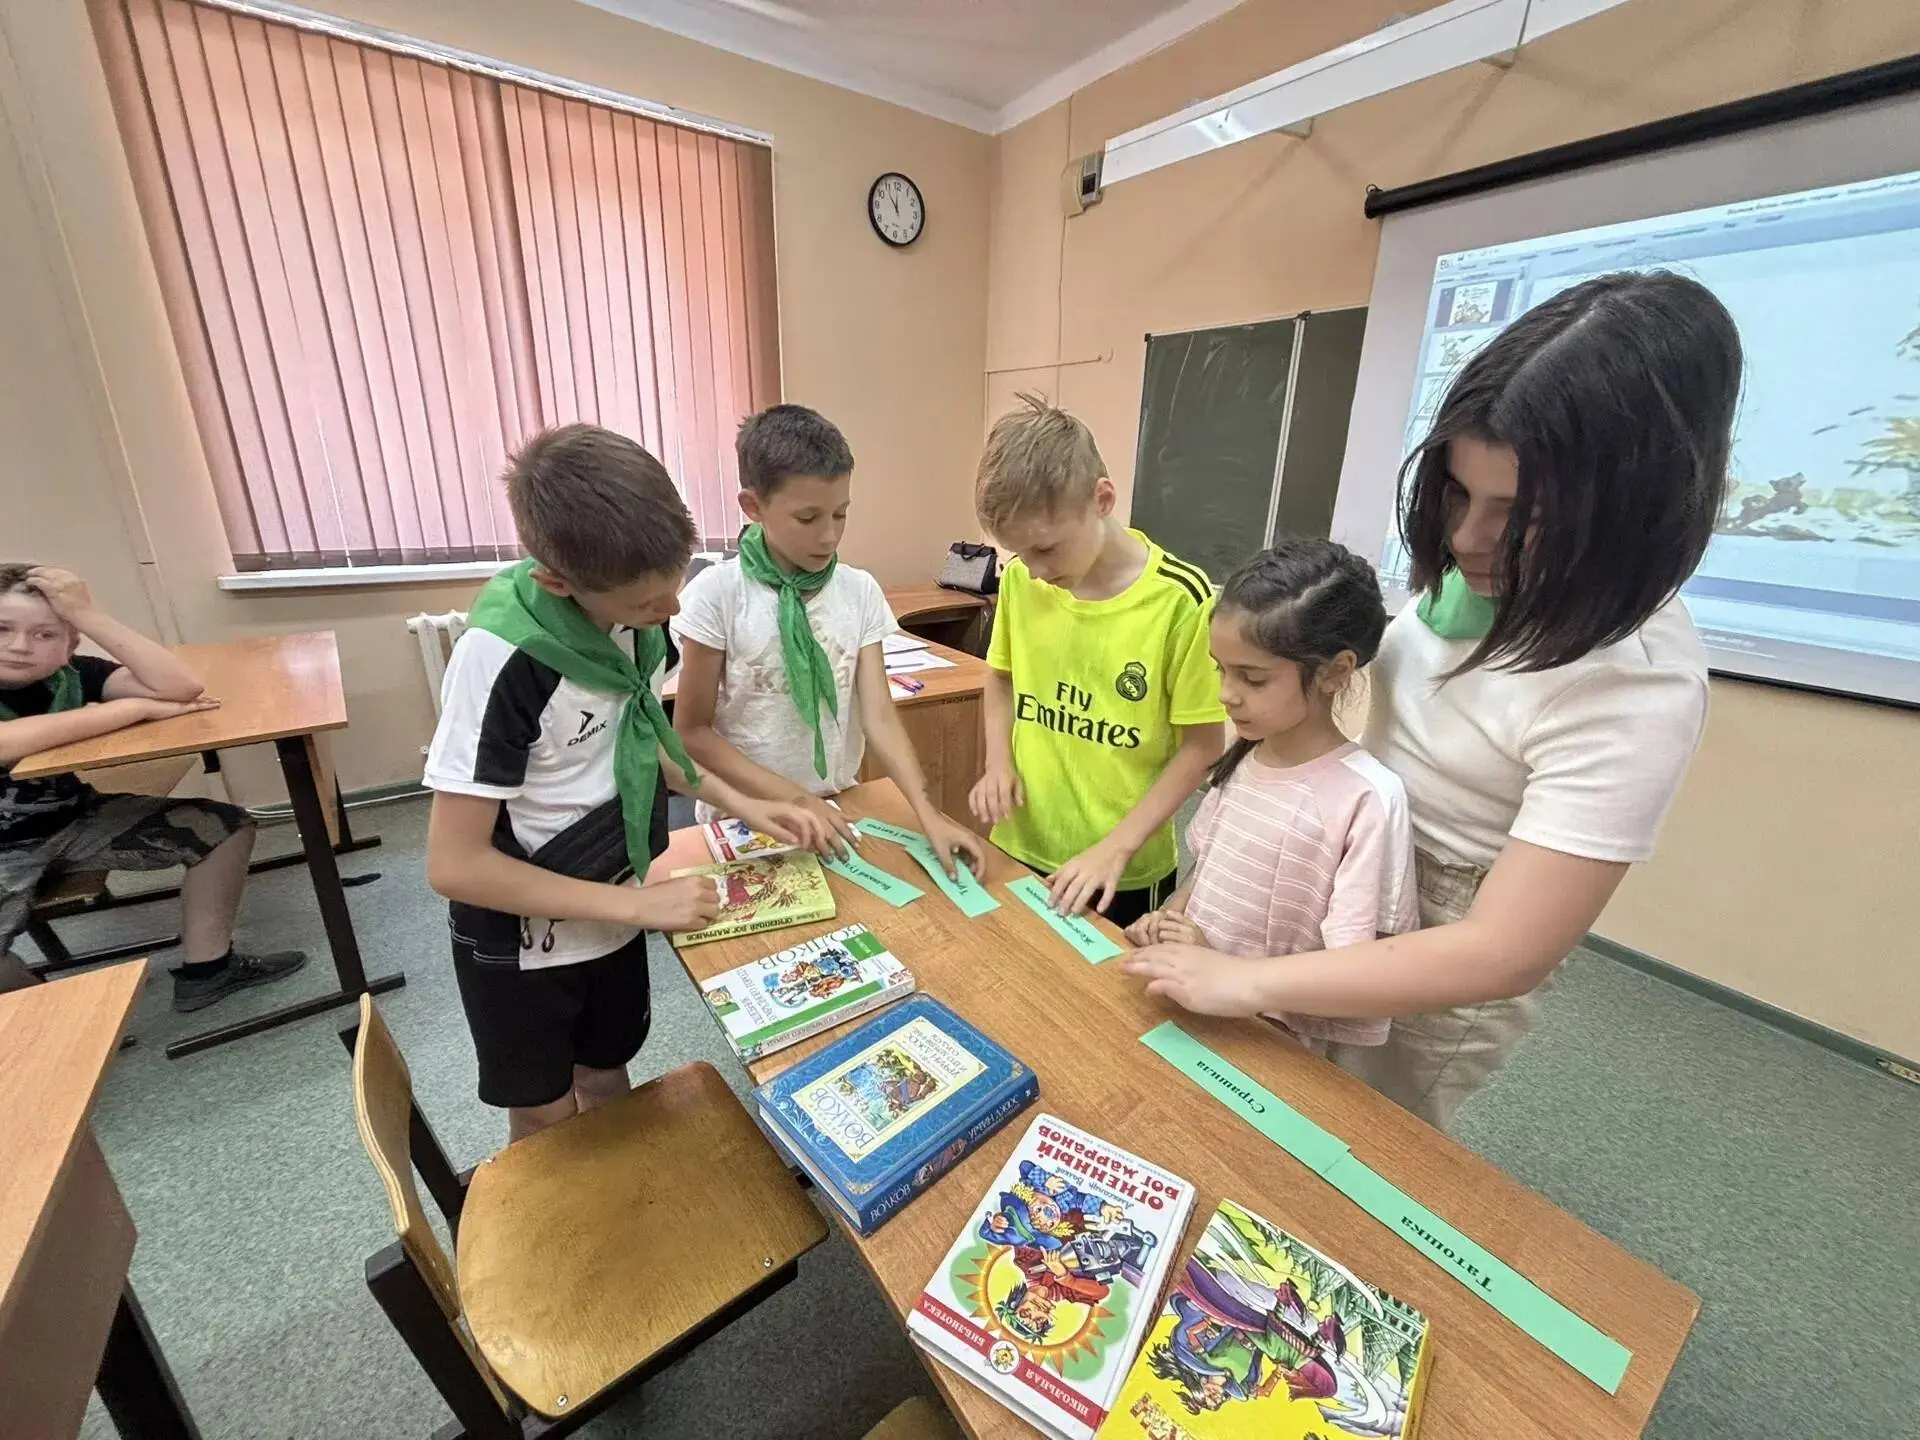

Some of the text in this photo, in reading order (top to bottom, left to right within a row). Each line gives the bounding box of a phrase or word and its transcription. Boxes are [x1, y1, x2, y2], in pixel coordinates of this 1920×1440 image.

[1017, 693, 1141, 749] Emirates
[1056, 681, 1093, 712] Fly
[567, 720, 608, 747] DEMIX
[756, 922, 864, 971] ВОЛКОВ
[1196, 1060, 1267, 1116] Страшила
[809, 1085, 874, 1150] ВОЛКОВ
[1036, 1140, 1165, 1212] ОГНЕННЫЙ
[1400, 1215, 1492, 1293] Татошка
[921, 1300, 986, 1347] БИБЛИОТЕКА
[1024, 1367, 1091, 1417] ШКОЛЬНАЯ
